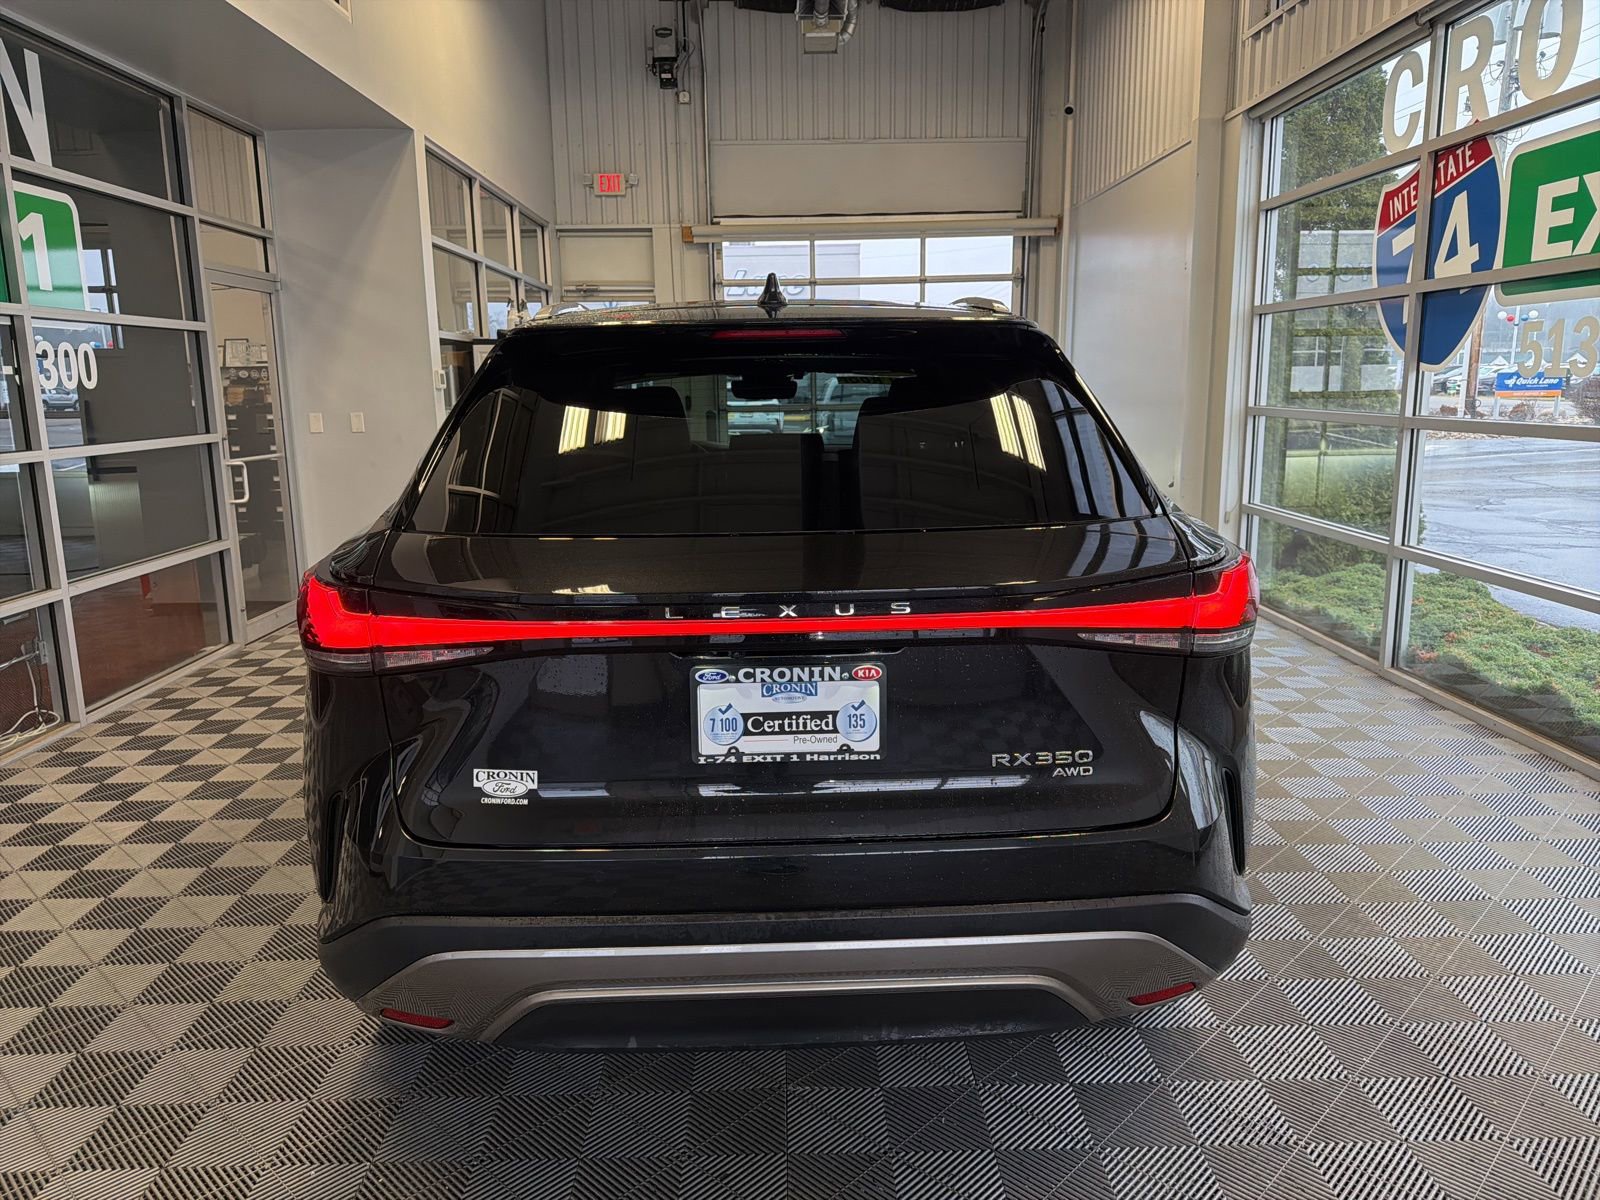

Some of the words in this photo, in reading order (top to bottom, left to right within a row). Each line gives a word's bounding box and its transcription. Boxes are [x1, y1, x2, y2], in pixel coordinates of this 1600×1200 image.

[599, 174, 621, 192] EXIT
[1389, 142, 1475, 223] INTETATE
[18, 211, 53, 292] 1
[727, 269, 806, 297] Lae
[1517, 315, 1600, 378] 513
[1516, 376, 1539, 385] Quick
[1539, 377, 1560, 385] Lane
[665, 602, 911, 619] LEXUS
[702, 672, 722, 681] Ford
[737, 667, 841, 683] CRONIN
[857, 669, 878, 678] KIA
[763, 683, 817, 697] CRONIN
[719, 717, 738, 733] 100
[746, 714, 834, 733] Certified
[847, 713, 866, 729] 135
[793, 735, 838, 744] Pre-Owned
[697, 755, 738, 764] I-74
[742, 754, 785, 763] EXIT
[789, 754, 800, 762] 1
[805, 752, 881, 761] Harrison
[475, 770, 535, 784] CRONIN
[1052, 766, 1094, 778] AWD
[492, 781, 518, 793] Ford
